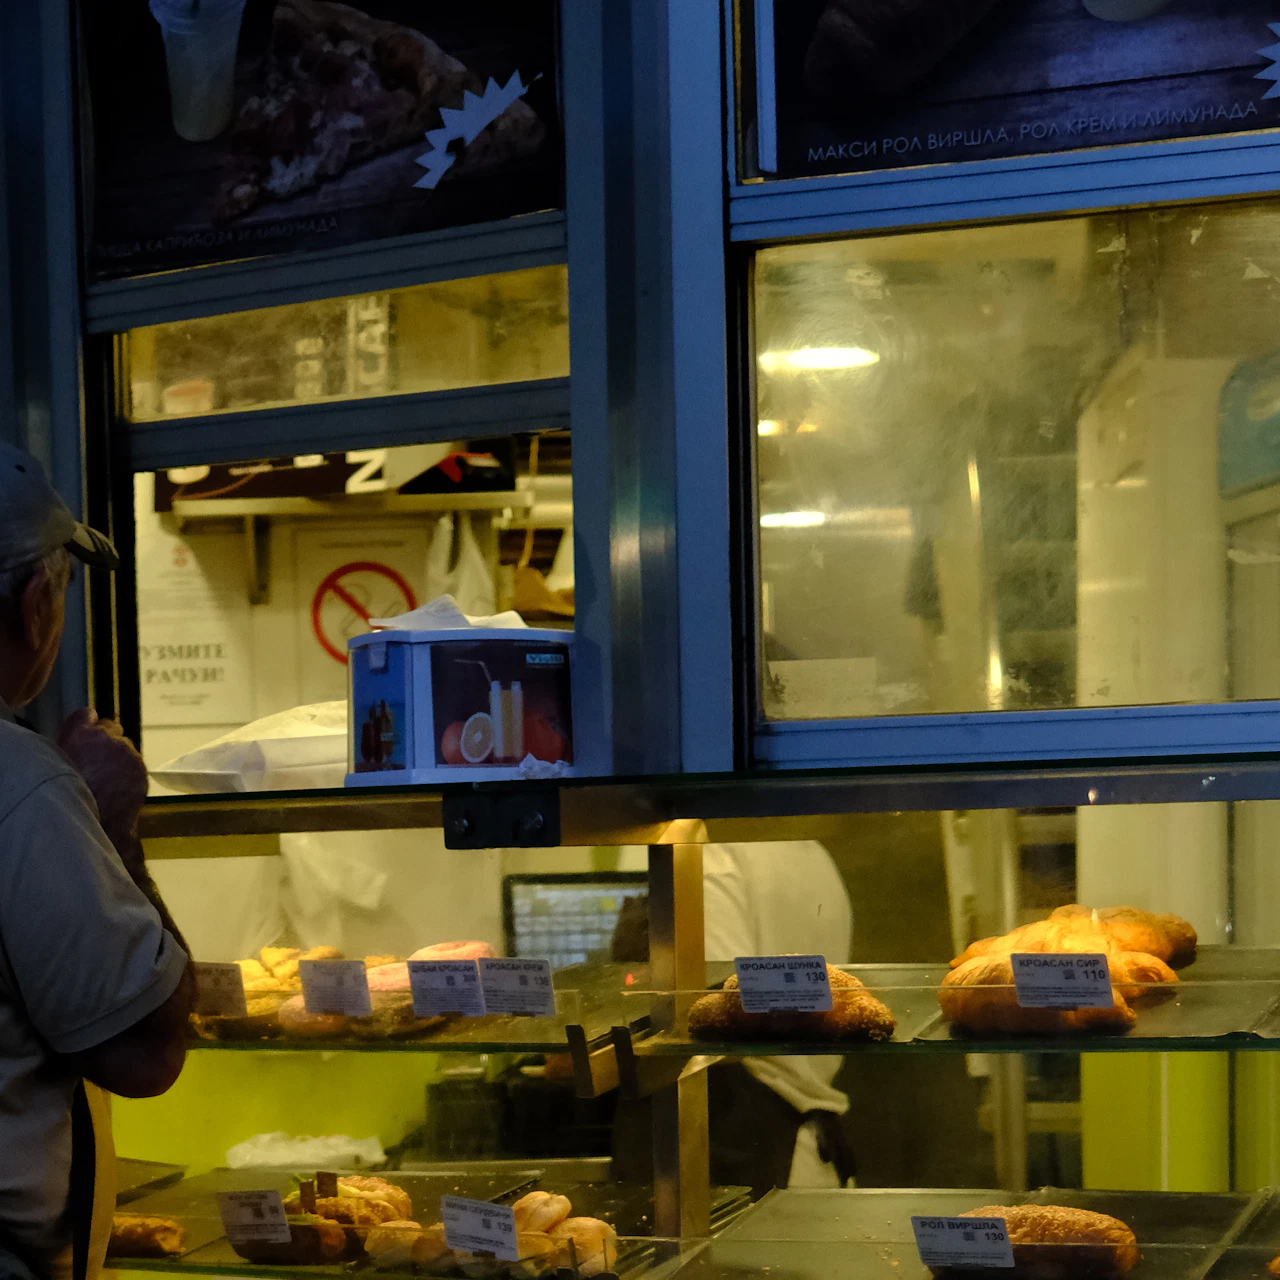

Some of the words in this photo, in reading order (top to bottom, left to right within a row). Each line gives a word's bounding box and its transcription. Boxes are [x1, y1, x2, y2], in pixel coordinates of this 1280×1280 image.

[807, 139, 878, 163] МАКСИ
[882, 136, 922, 154] РОЛ
[927, 127, 1014, 151] ВИРШЛА,
[1019, 121, 1060, 140] РОЛ
[1065, 115, 1116, 135] КРЕМ
[1123, 115, 1138, 130] И
[1142, 100, 1258, 128] ЛИМУНАДА
[238, 227, 251, 242] И
[255, 216, 339, 239] ЛИМУНАДА
[739, 962, 786, 971] КРОАСАН
[787, 961, 822, 970] ШУНКА
[1018, 959, 1074, 968] КРОАСАН
[1075, 959, 1101, 968] СИР
[805, 971, 826, 982] 130
[1082, 969, 1106, 980] 110
[920, 1220, 945, 1230] РОЛ
[947, 1220, 999, 1230] ВИРШЛА
[984, 1232, 1005, 1241] 130
